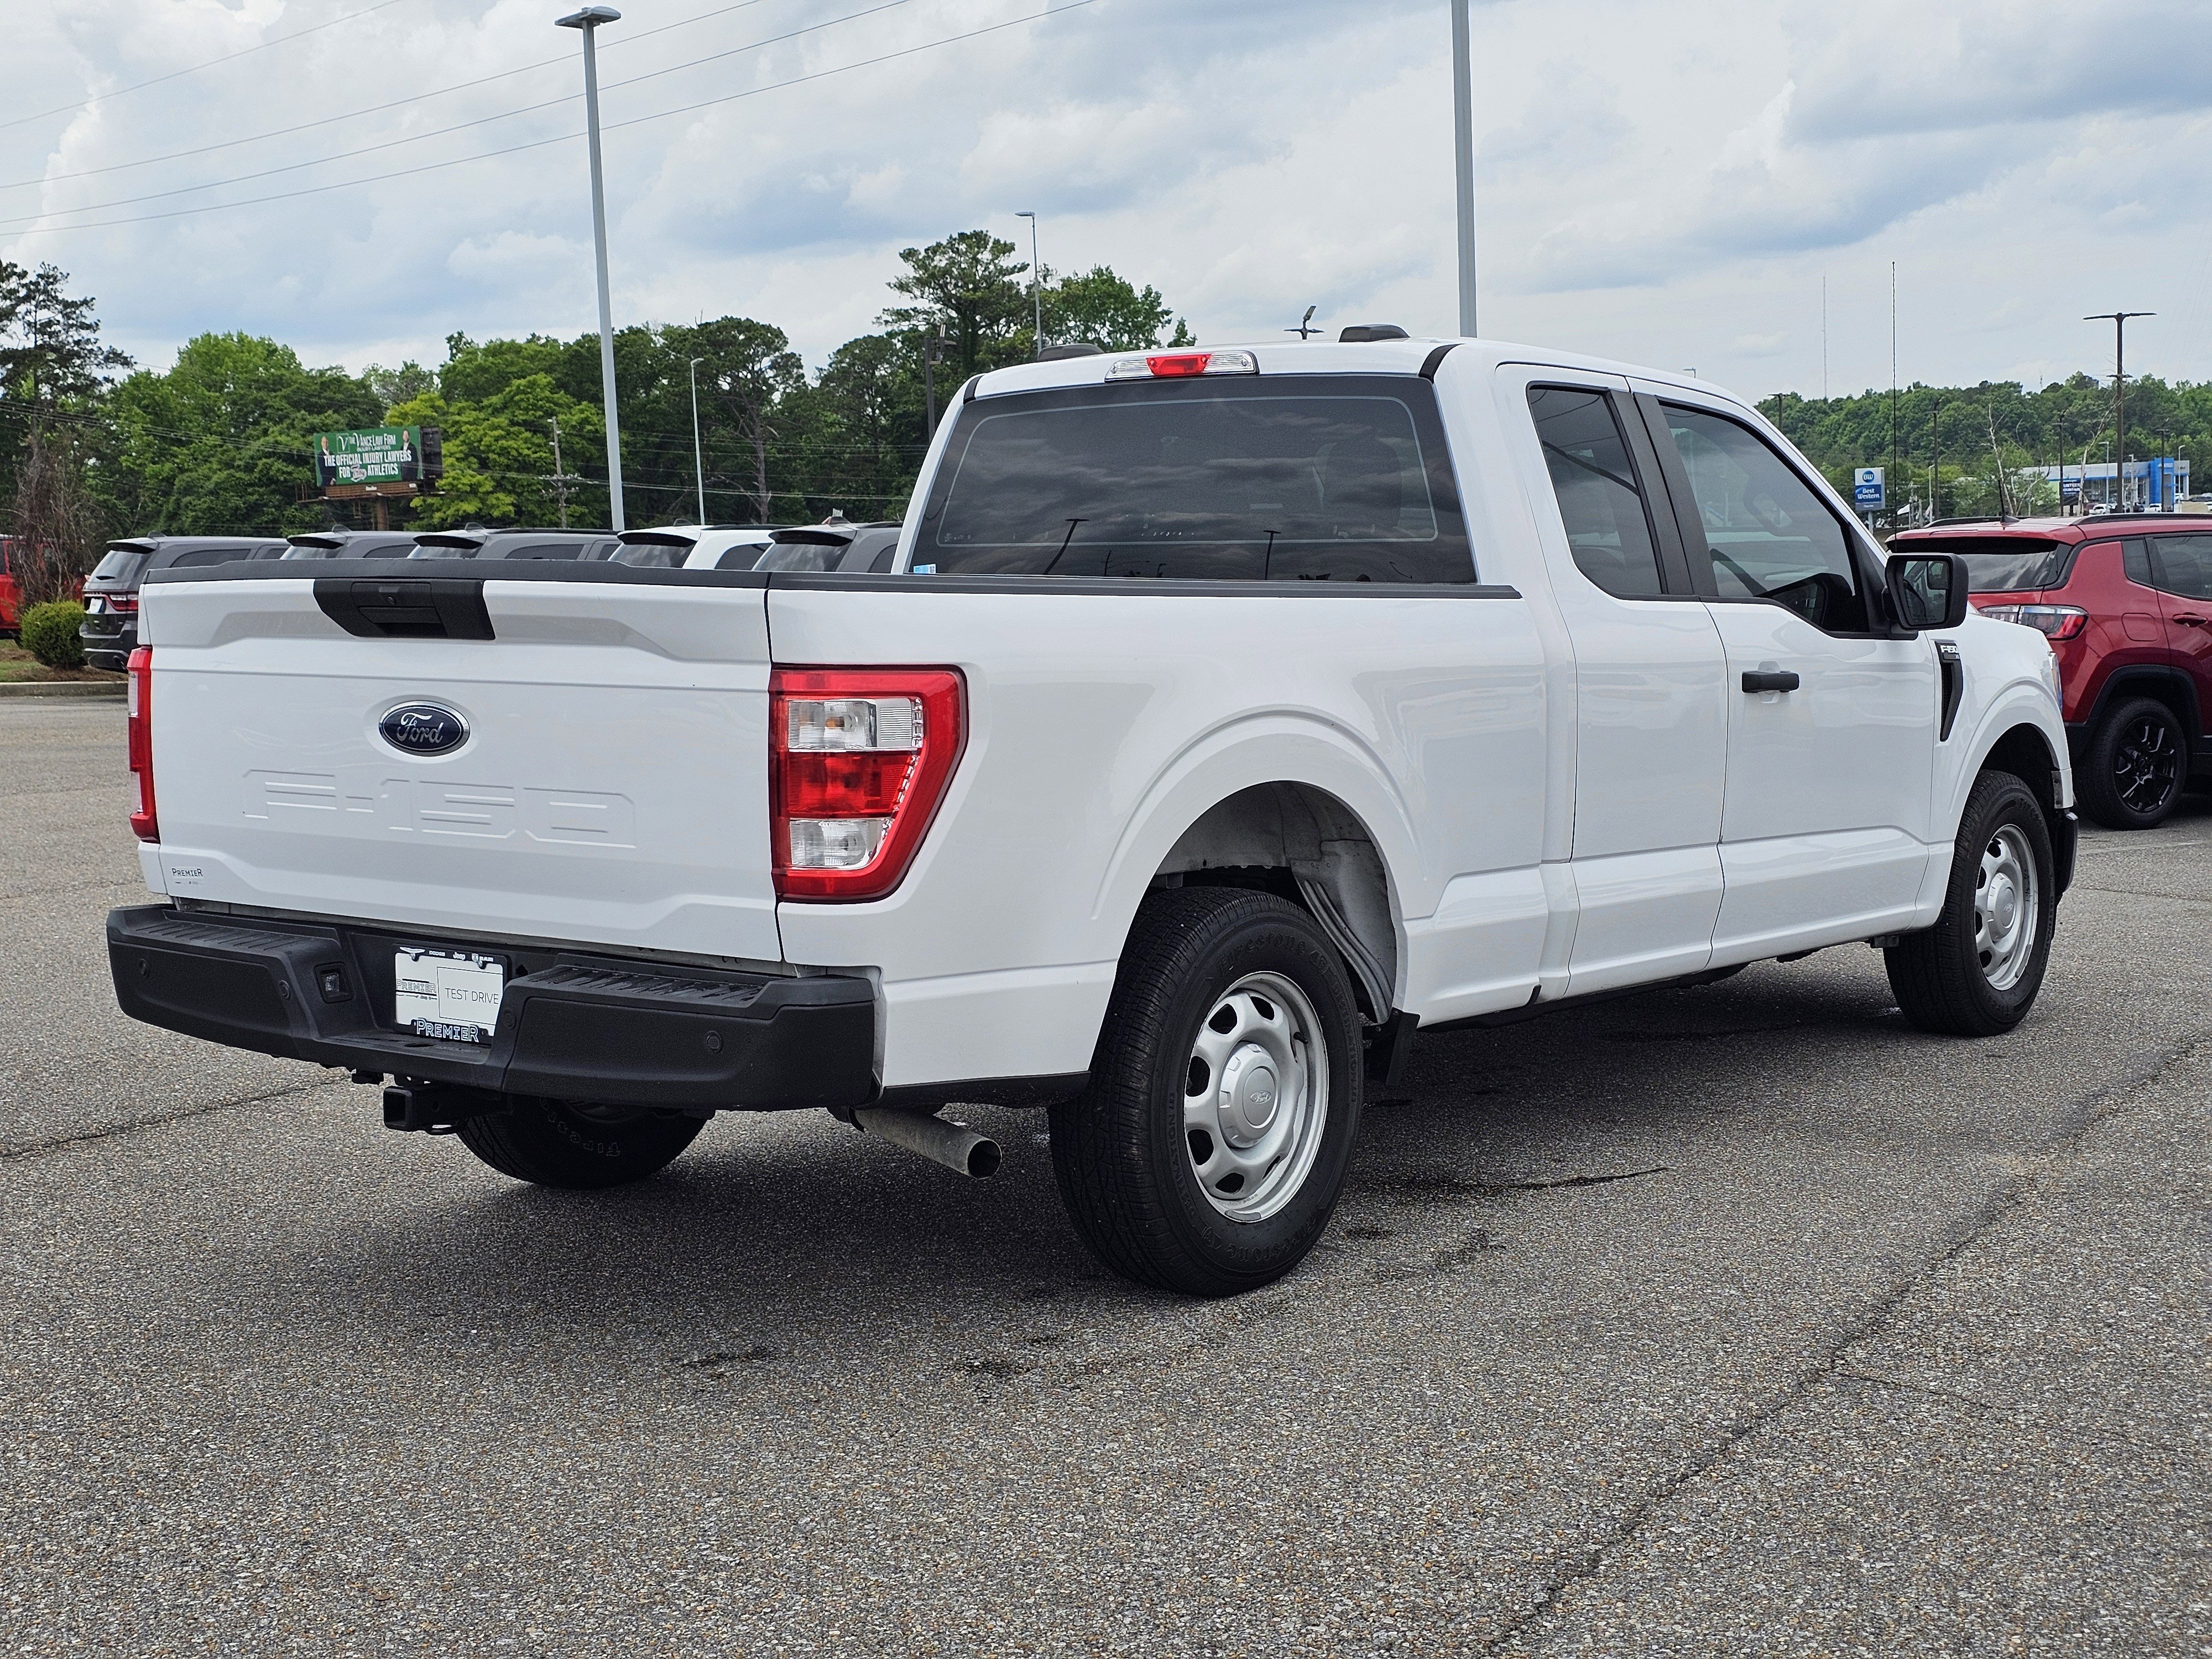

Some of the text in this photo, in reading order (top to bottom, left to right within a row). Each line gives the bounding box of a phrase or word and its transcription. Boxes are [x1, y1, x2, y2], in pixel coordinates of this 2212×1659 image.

[372, 434, 383, 446] LAW
[384, 433, 396, 445] FIRM
[324, 450, 412, 466] THE OFFICIAL INJURY LAWYERS
[339, 466, 351, 478] FOR
[367, 463, 399, 476] ATHLETICS
[397, 712, 444, 744] Ford
[243, 769, 637, 849] F-150
[172, 868, 204, 877] PREMIER
[453, 952, 466, 961] Jeep
[396, 979, 437, 993] PREMIER
[445, 987, 499, 1004] TEST DRIVE
[416, 1018, 479, 1043] PREMIER
